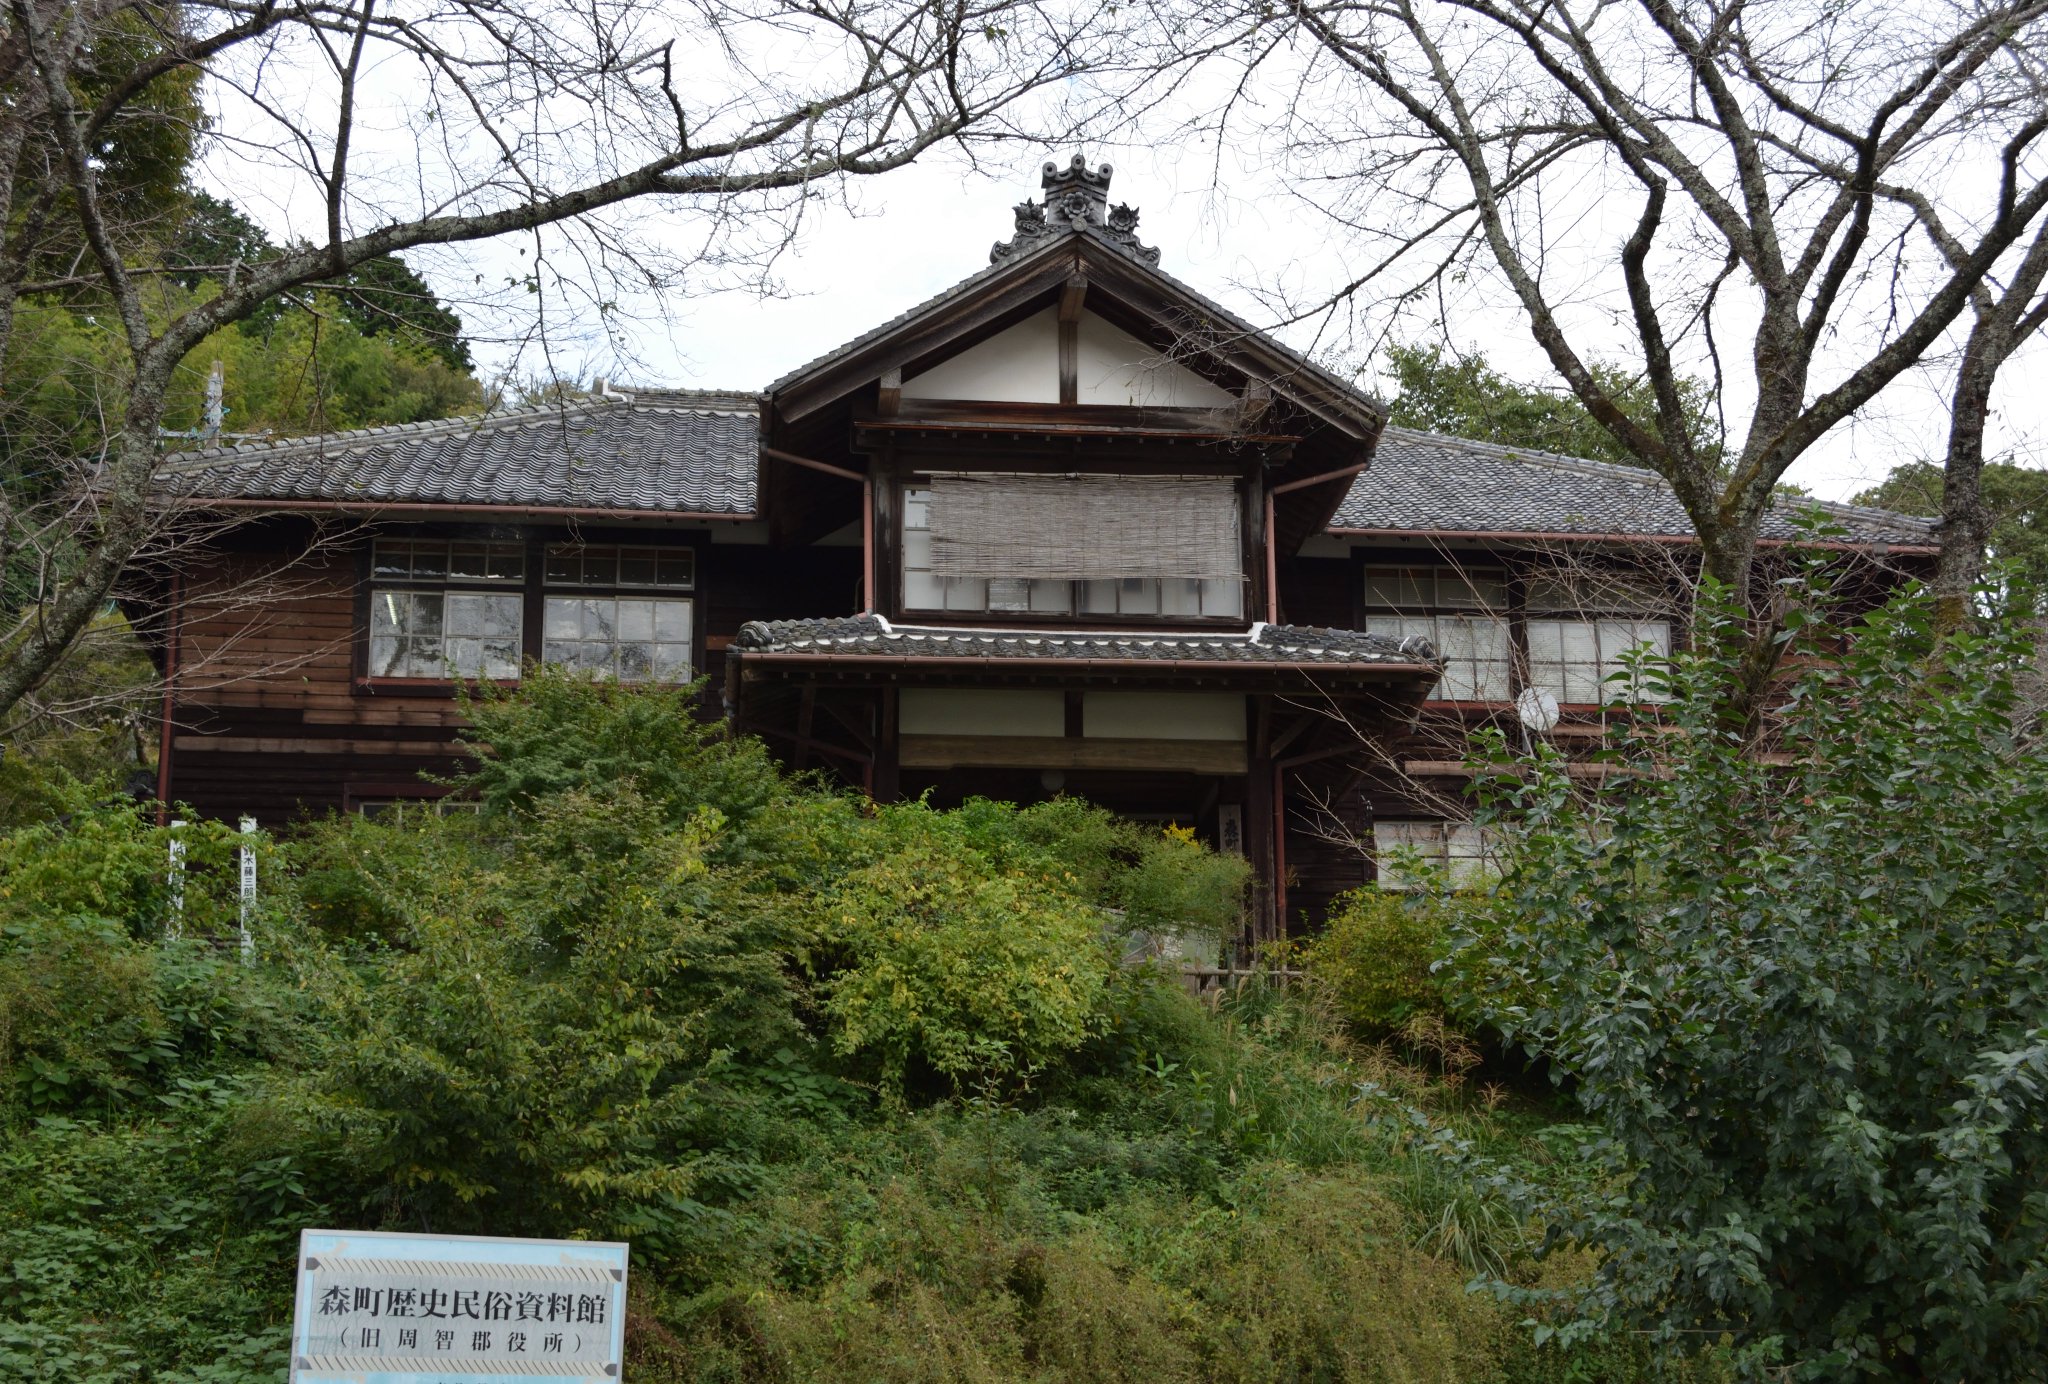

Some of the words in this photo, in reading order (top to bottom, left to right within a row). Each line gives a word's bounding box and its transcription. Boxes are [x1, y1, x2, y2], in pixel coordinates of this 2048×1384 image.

[318, 1285, 606, 1324] 森町歴史民俗資料館
[340, 1327, 582, 1353] （旧周智郡役所）
